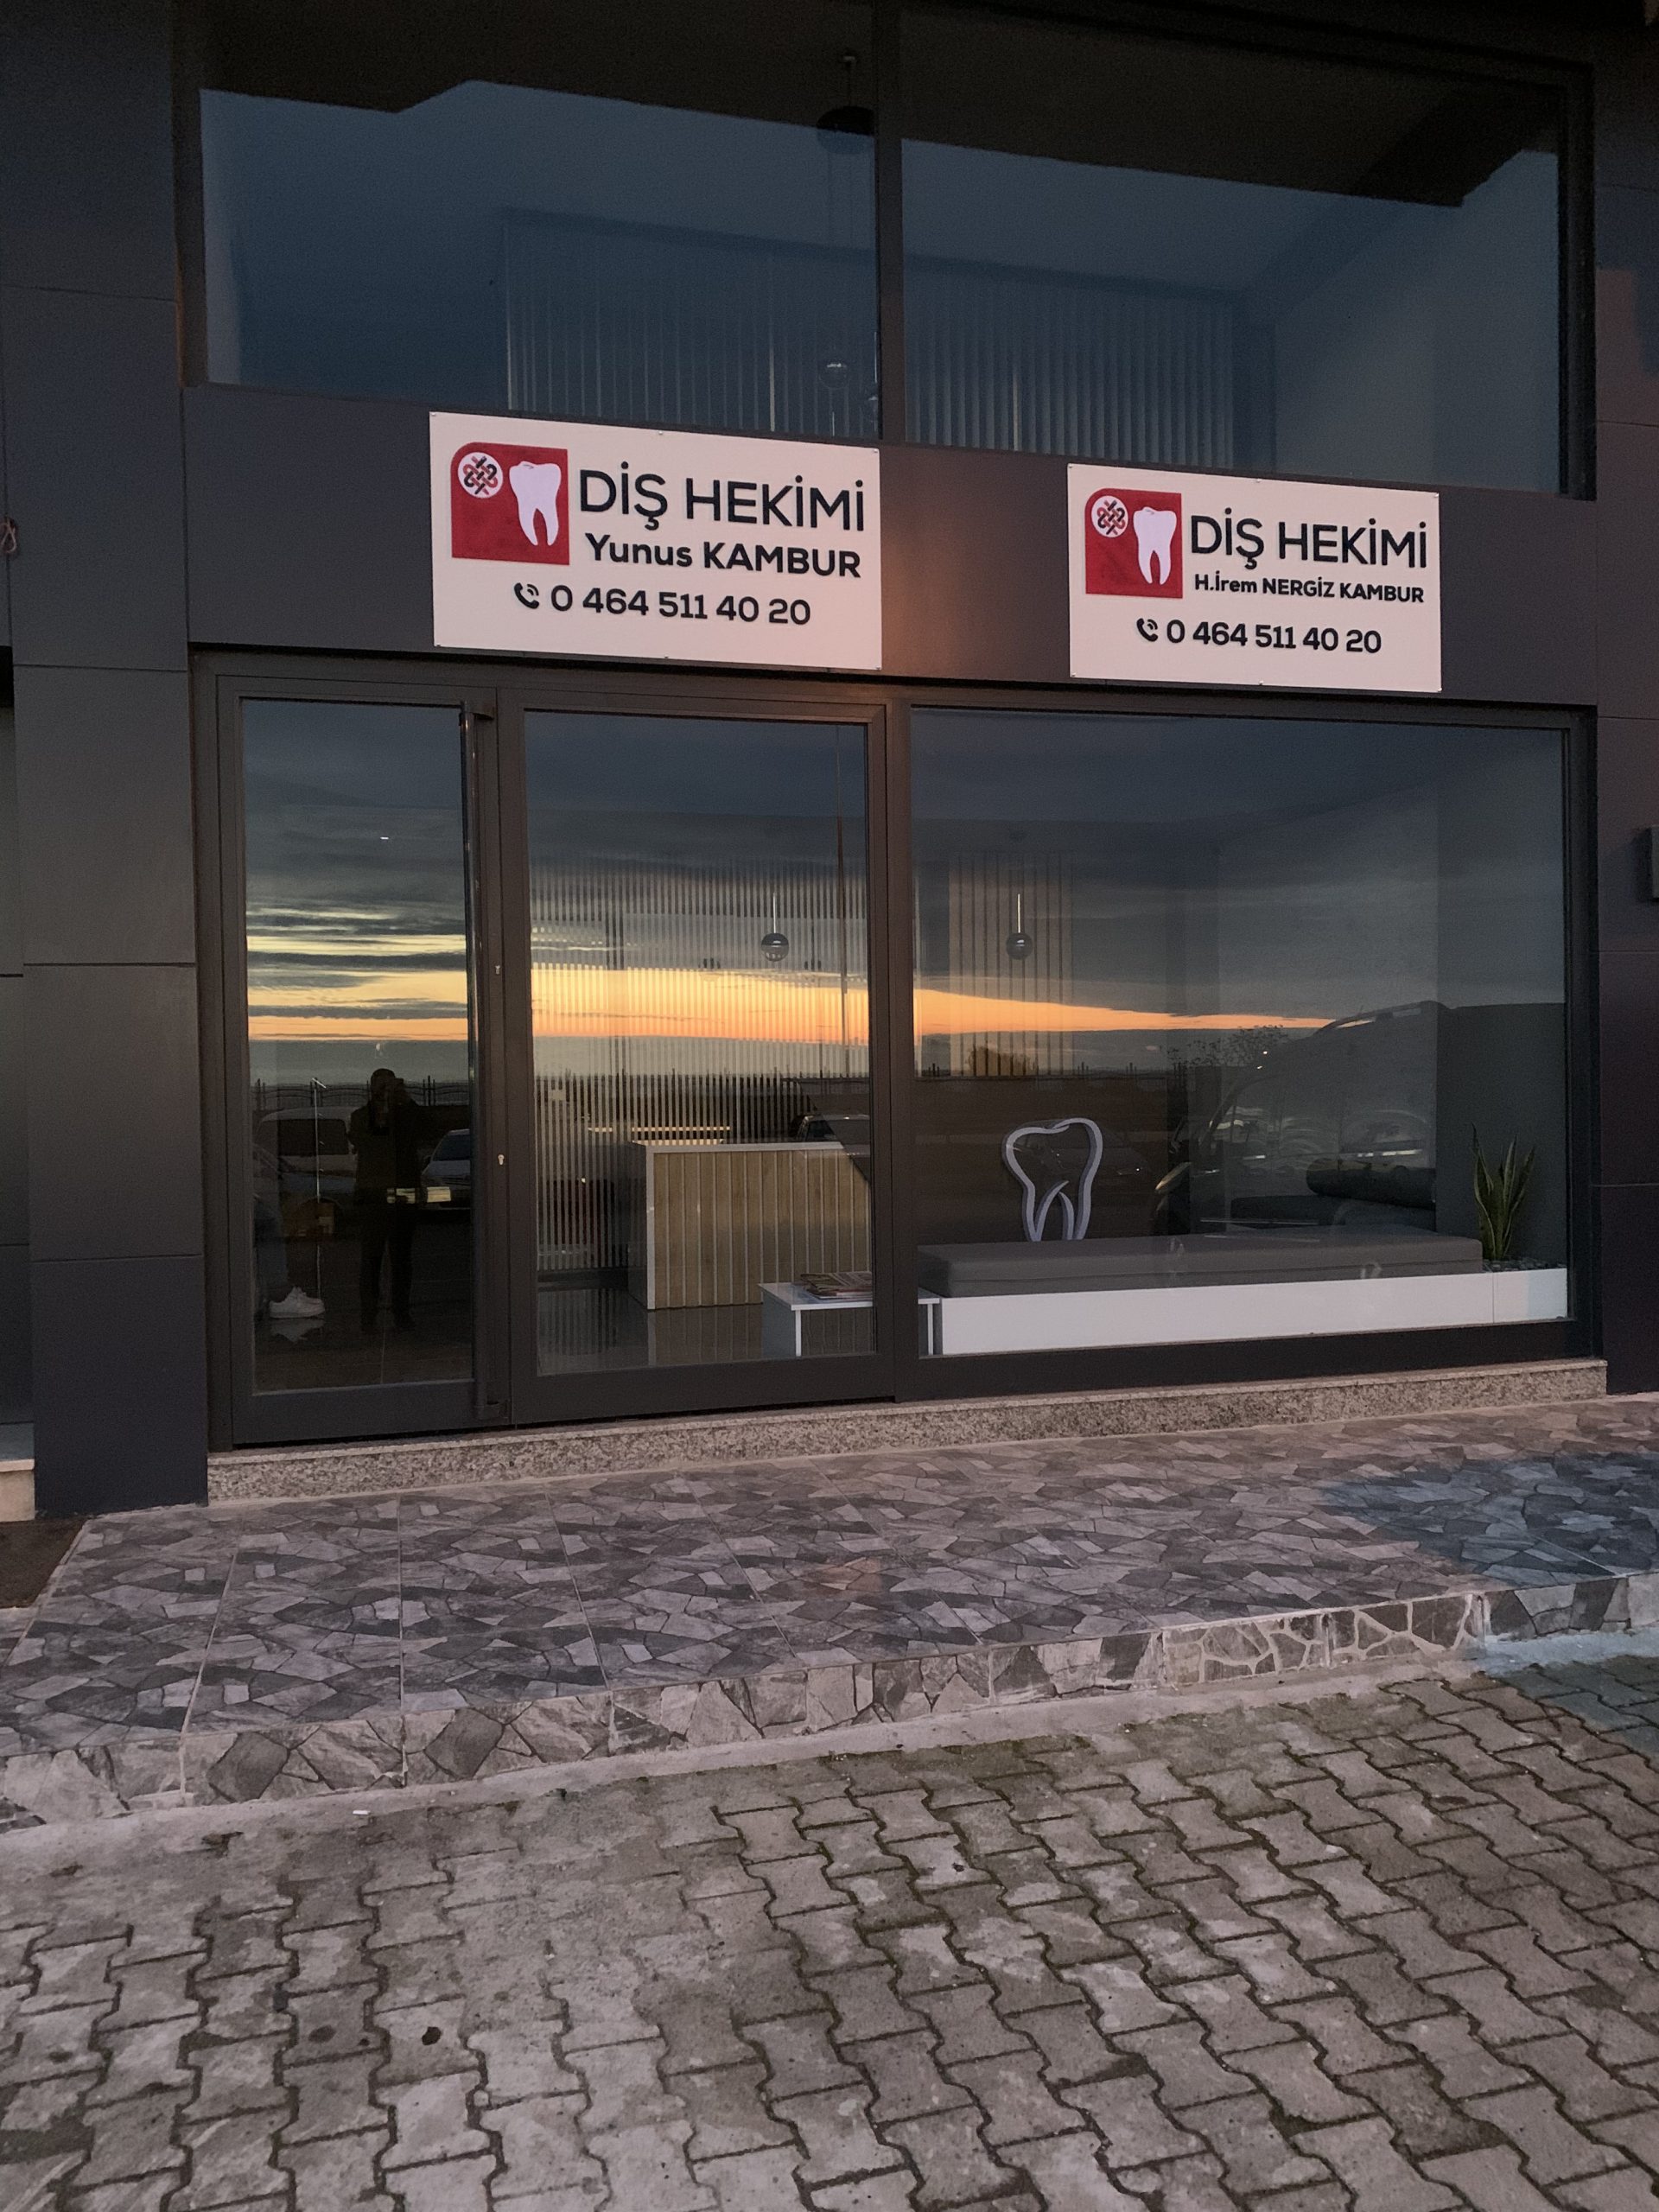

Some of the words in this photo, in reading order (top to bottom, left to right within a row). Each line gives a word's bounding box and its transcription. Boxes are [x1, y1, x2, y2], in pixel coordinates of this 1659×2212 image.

[580, 461, 667, 531] DİŞ
[686, 475, 863, 531] HEKİMİ
[585, 533, 692, 567] Yunus
[704, 542, 861, 578] KAMBUR
[1192, 507, 1264, 569] DİŞ
[1279, 518, 1427, 568] HEKİMİ
[551, 585, 573, 612] 0
[582, 588, 649, 615] 464
[659, 592, 708, 619] 511
[716, 596, 759, 622] 40
[769, 599, 810, 625] 20
[1262, 576, 1335, 597] NERGİZ
[1340, 583, 1424, 602] KAMBUR
[1167, 620, 1185, 643] 0
[1193, 622, 1248, 646] 464
[1255, 625, 1296, 649] 511
[1303, 627, 1338, 651] 40
[1346, 630, 1381, 653] 20
